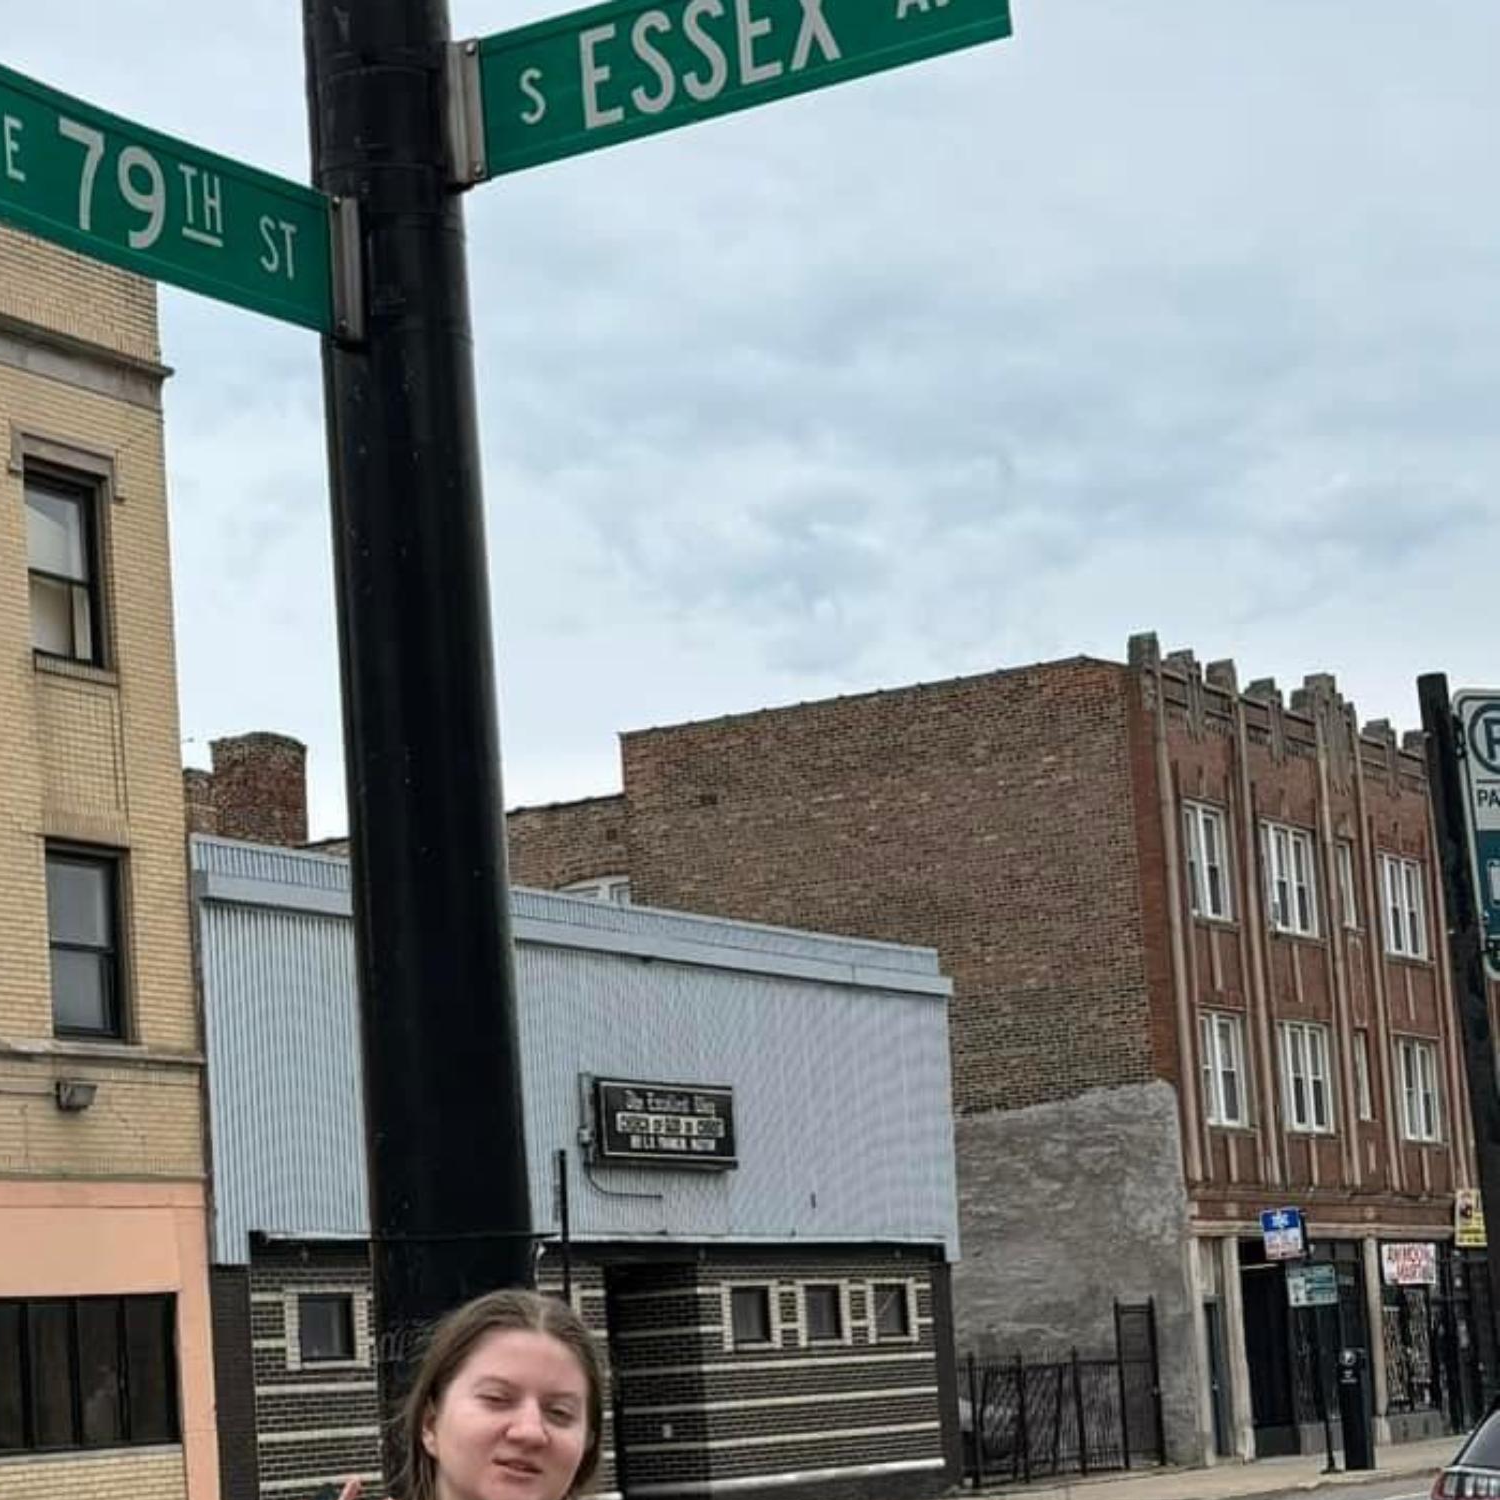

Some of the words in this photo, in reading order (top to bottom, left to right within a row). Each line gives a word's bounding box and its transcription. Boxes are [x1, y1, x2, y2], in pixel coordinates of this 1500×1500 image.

[520, 67, 546, 125] S
[579, 0, 842, 129] ESSEX
[4, 115, 26, 183] E
[259, 214, 298, 280] ST
